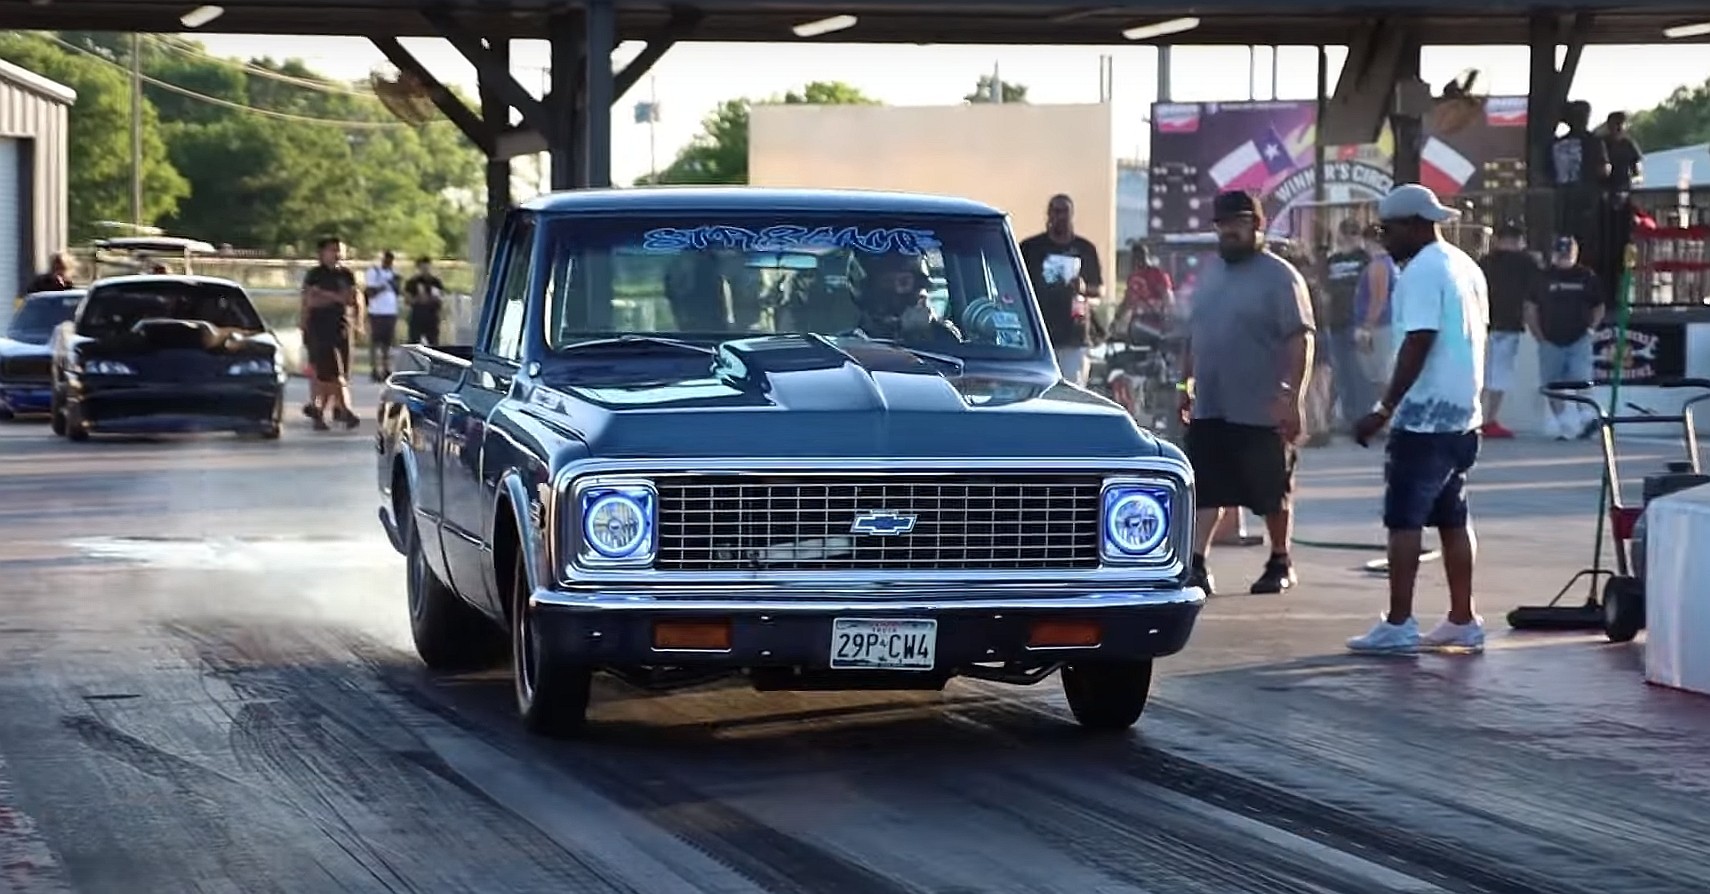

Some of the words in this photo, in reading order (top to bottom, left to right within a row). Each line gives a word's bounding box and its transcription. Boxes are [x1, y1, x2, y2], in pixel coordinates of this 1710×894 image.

[1275, 163, 1350, 203] WINNR'S
[837, 633, 879, 658] 29P
[889, 634, 928, 660] CW4
